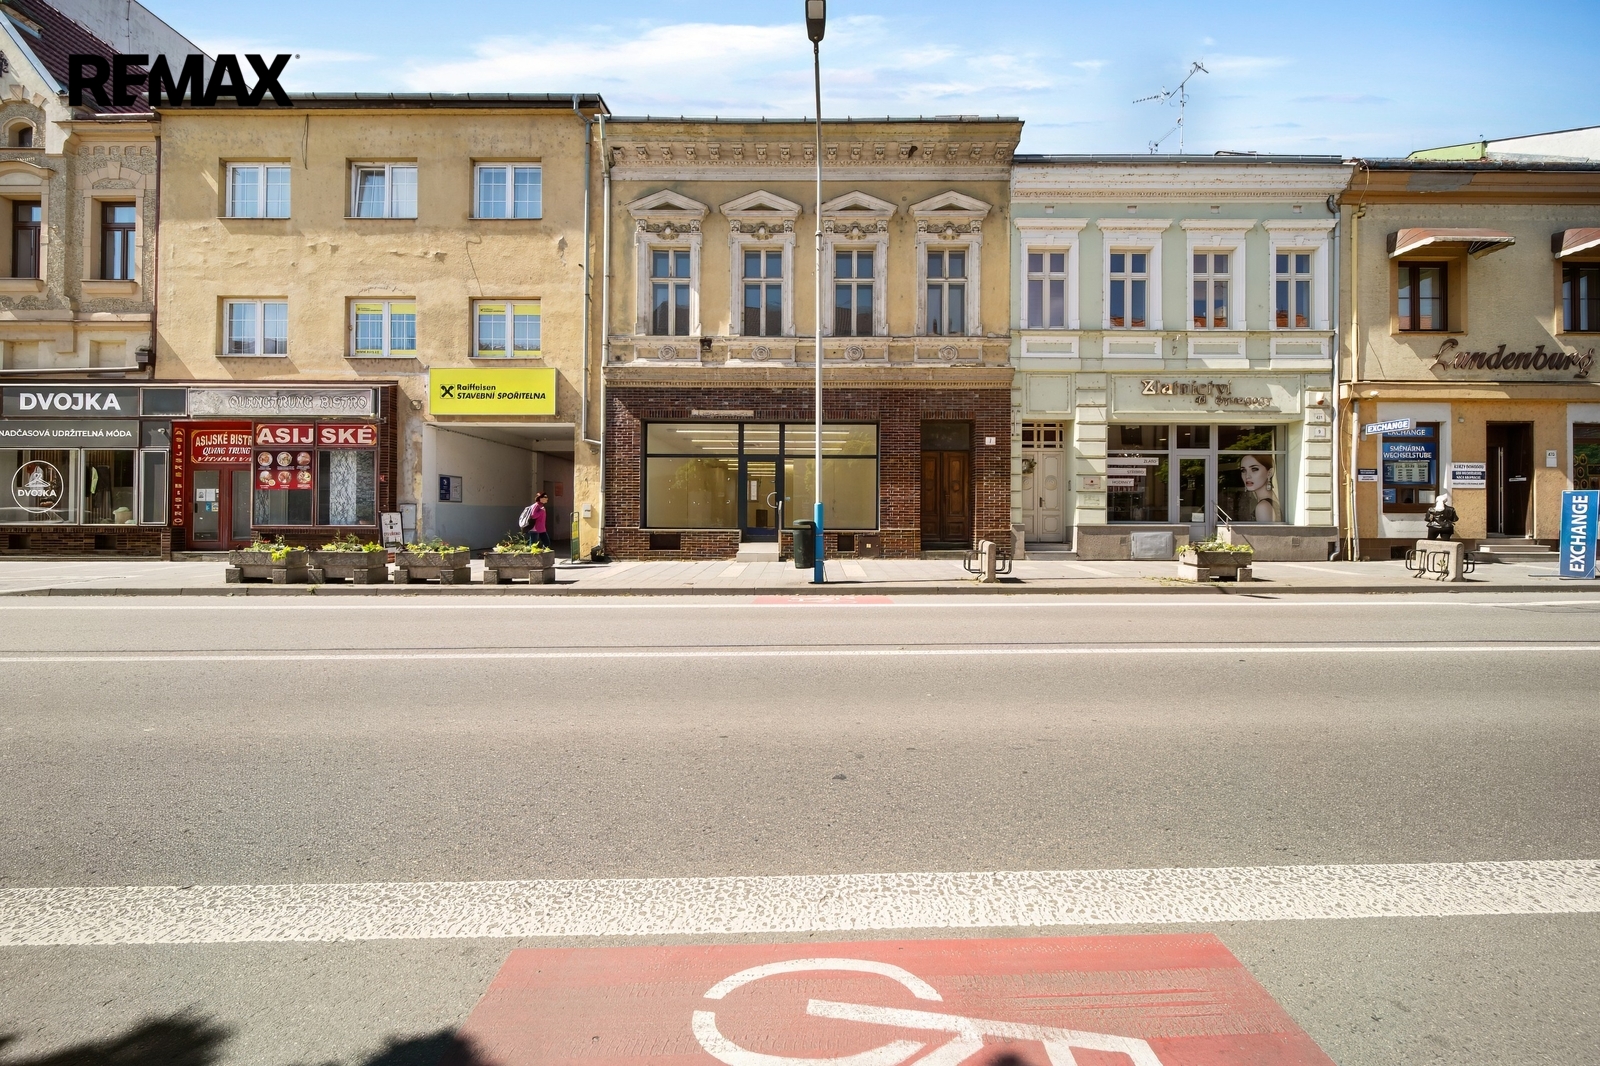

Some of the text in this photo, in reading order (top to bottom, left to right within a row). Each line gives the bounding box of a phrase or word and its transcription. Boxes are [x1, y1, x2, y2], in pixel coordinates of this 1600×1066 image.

[1429, 338, 1595, 379] Lundenburg
[19, 393, 121, 411] DVOJKA
[320, 395, 367, 410] BISTRO
[457, 391, 546, 400] STAVEBNÍ SPOŘITELNA
[0, 429, 132, 437] NADČASOVÁ UDRŽITELNÁ MÓDA
[1367, 420, 1409, 433] EXCHANGE
[195, 431, 229, 447] ASIJSKÉ
[203, 447, 251, 456] QUANG TRUNG
[18, 489, 56, 497] DVOJKA
[174, 483, 183, 523] BISTRO
[1569, 495, 1588, 572] EXCHANGE
